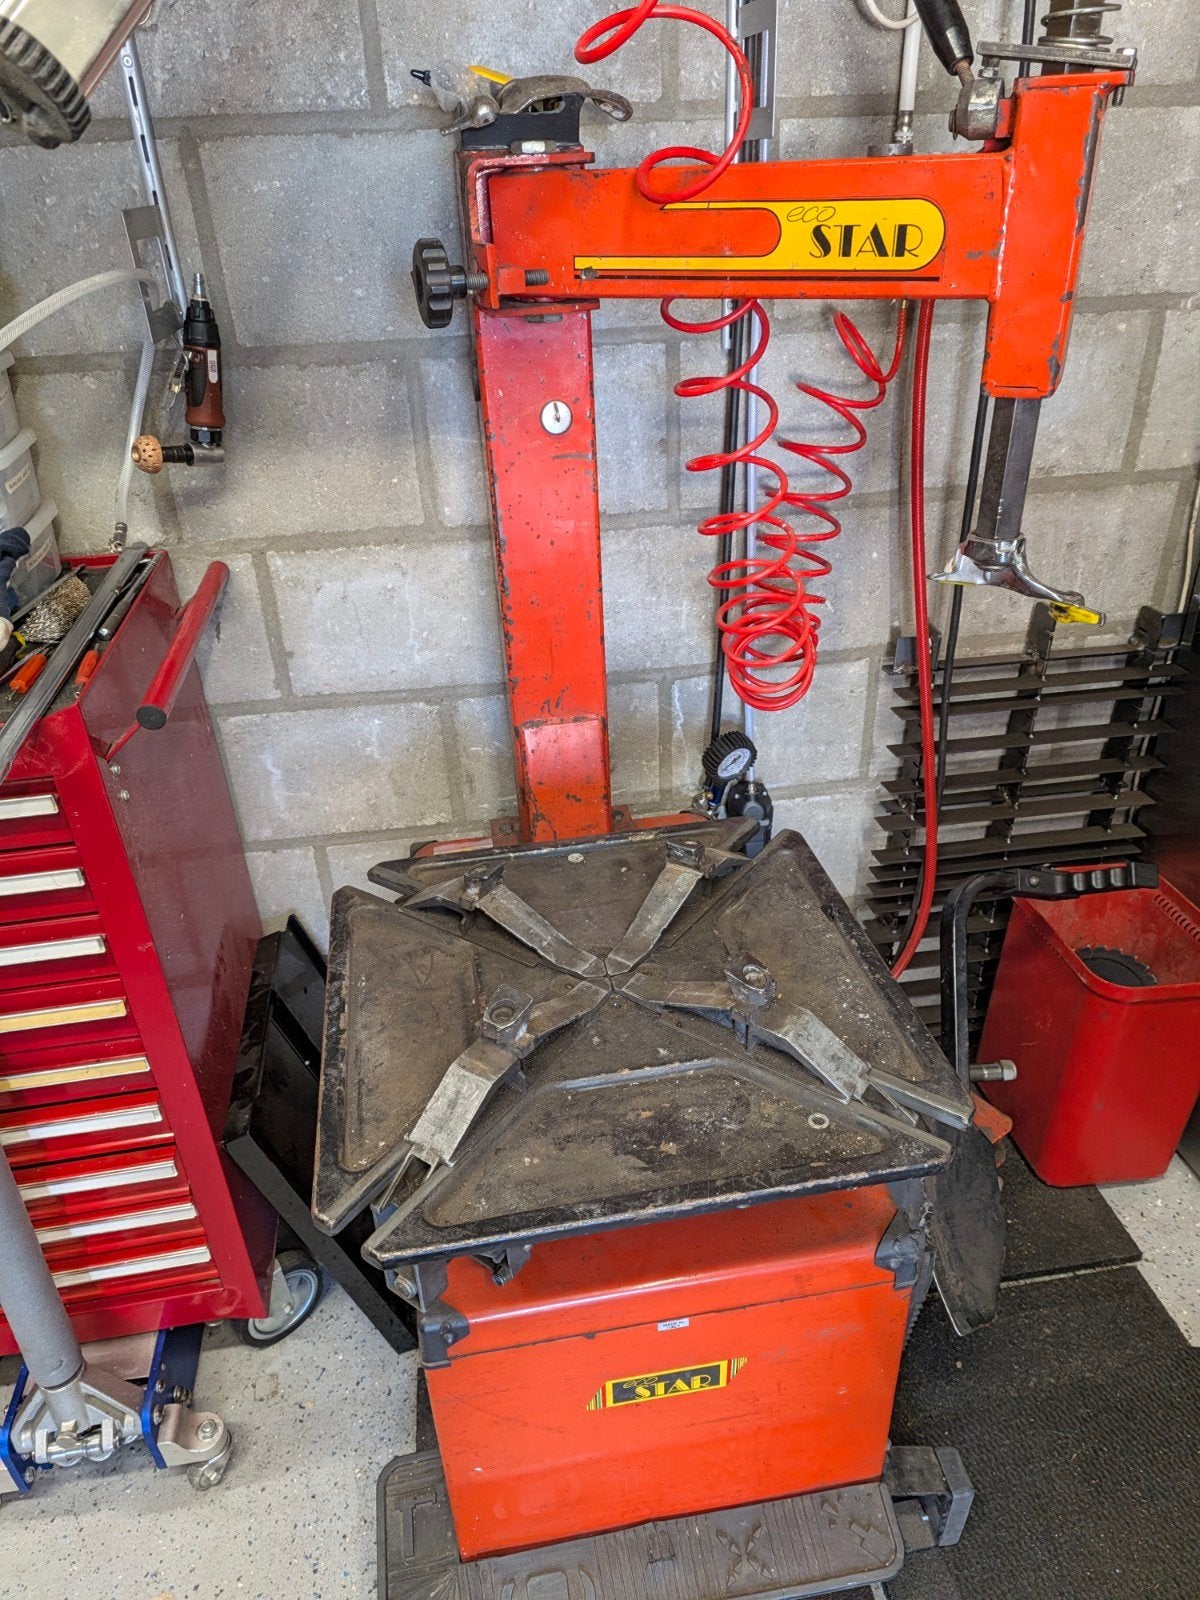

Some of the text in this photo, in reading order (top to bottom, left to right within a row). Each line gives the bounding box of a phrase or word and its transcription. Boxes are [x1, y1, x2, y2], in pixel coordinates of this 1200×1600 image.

[786, 206, 836, 223] eco
[809, 223, 923, 259] STAR
[623, 1376, 658, 1389] eco
[634, 1374, 712, 1400] STAR
